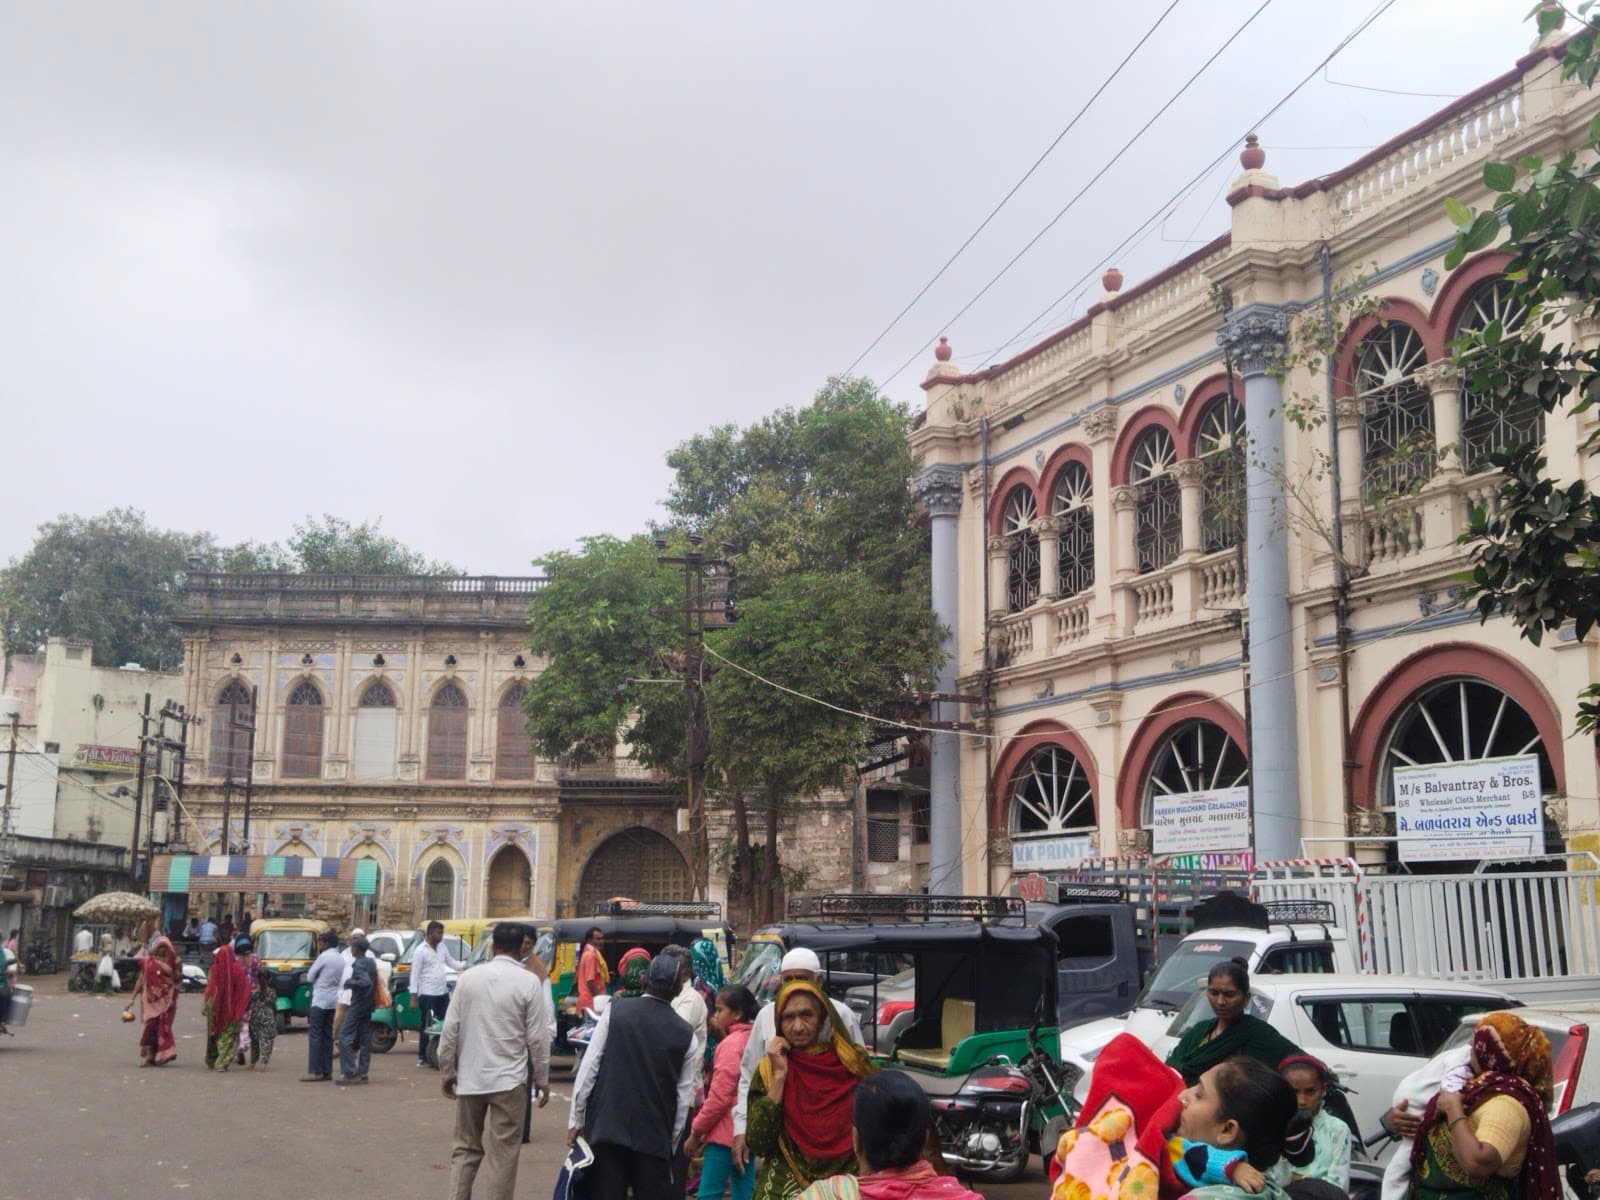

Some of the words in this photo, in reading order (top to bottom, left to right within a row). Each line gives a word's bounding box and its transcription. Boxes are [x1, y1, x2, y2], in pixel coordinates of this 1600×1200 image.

[1424, 779, 1486, 795] Balvantray
[1490, 776, 1499, 788] &
[1503, 775, 1533, 788] Bros.
[1419, 797, 1452, 807] Wholesale
[1455, 795, 1474, 805] Cloth
[1476, 793, 1511, 803] Merchant
[1172, 854, 1200, 870] SALE
